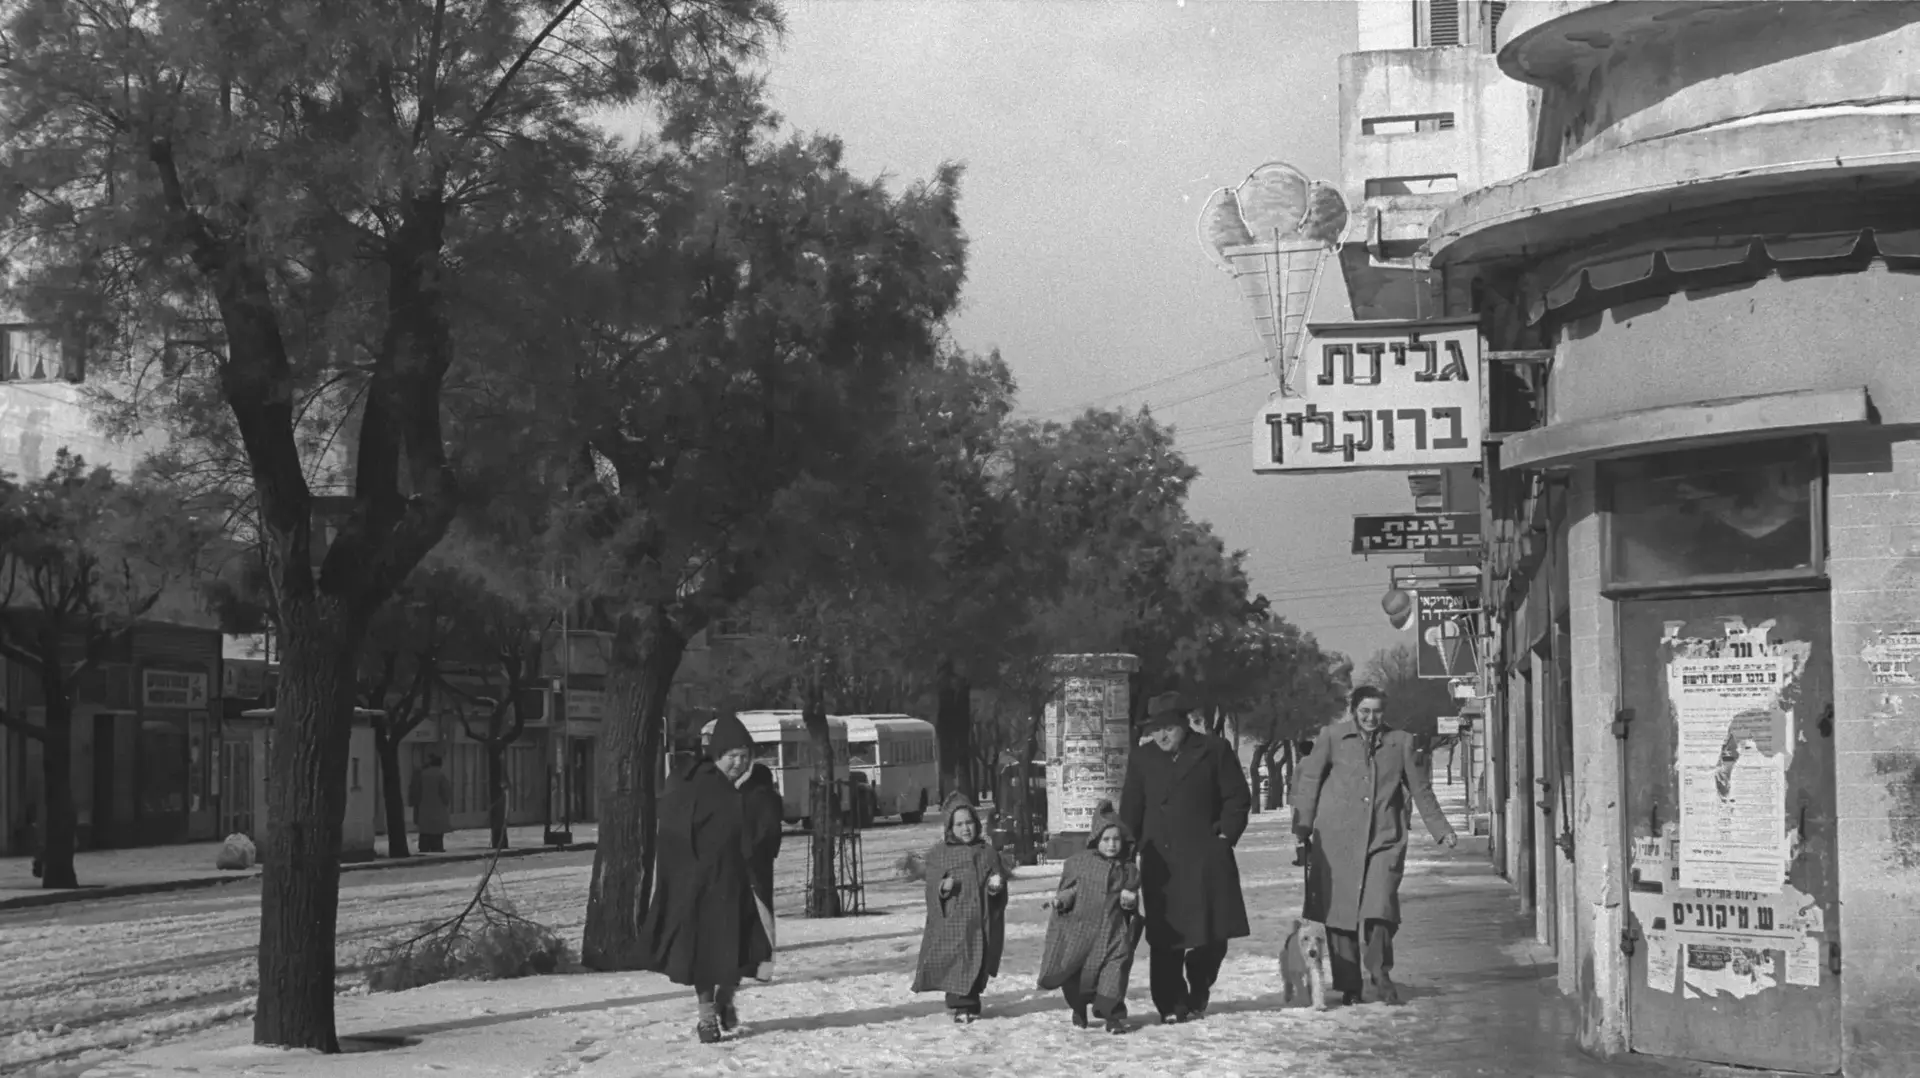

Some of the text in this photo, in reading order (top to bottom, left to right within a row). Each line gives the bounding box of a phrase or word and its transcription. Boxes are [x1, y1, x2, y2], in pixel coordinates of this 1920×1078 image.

[1317, 332, 1469, 385] גלידת
[1265, 404, 1468, 464] ברוקלין
[1360, 532, 1482, 549] ברוקלין
